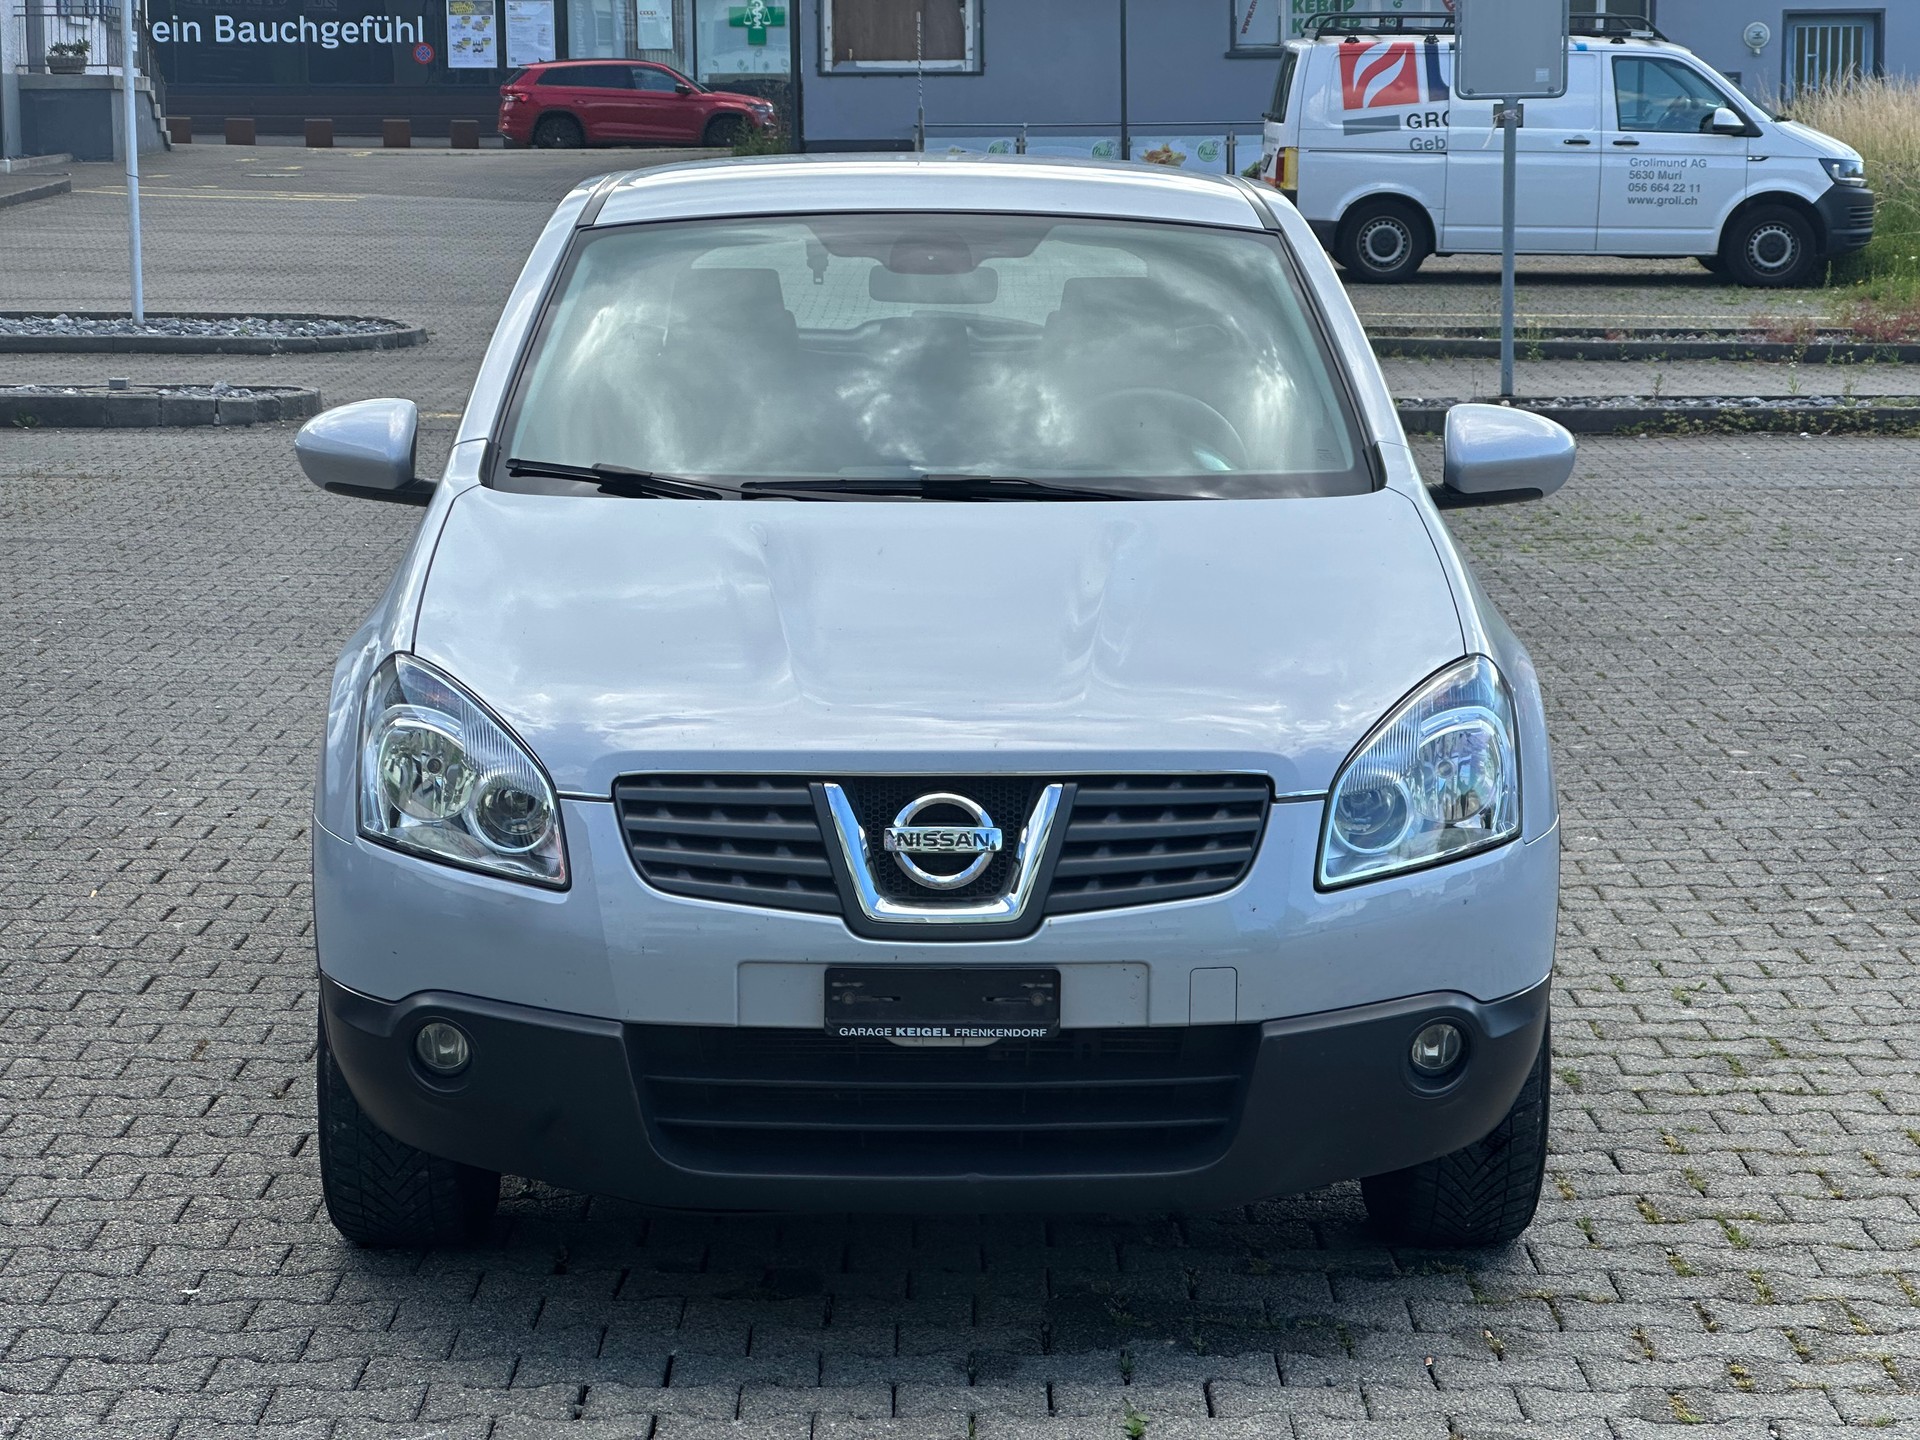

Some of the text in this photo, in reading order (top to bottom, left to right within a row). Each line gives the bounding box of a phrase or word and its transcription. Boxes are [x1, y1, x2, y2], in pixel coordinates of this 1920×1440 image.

[215, 15, 424, 49] Bauchgefühl
[1409, 135, 1446, 151] Geb
[1629, 157, 1707, 168] Grolimund AG
[1629, 170, 1682, 180] 5630 Muri
[1628, 183, 1701, 193] 056 664 22 11
[1627, 196, 1698, 207] www.groli.ch
[896, 831, 990, 848] NISSAN
[839, 1027, 1047, 1037] GARAGE KEIGEL FRENKENDORF
